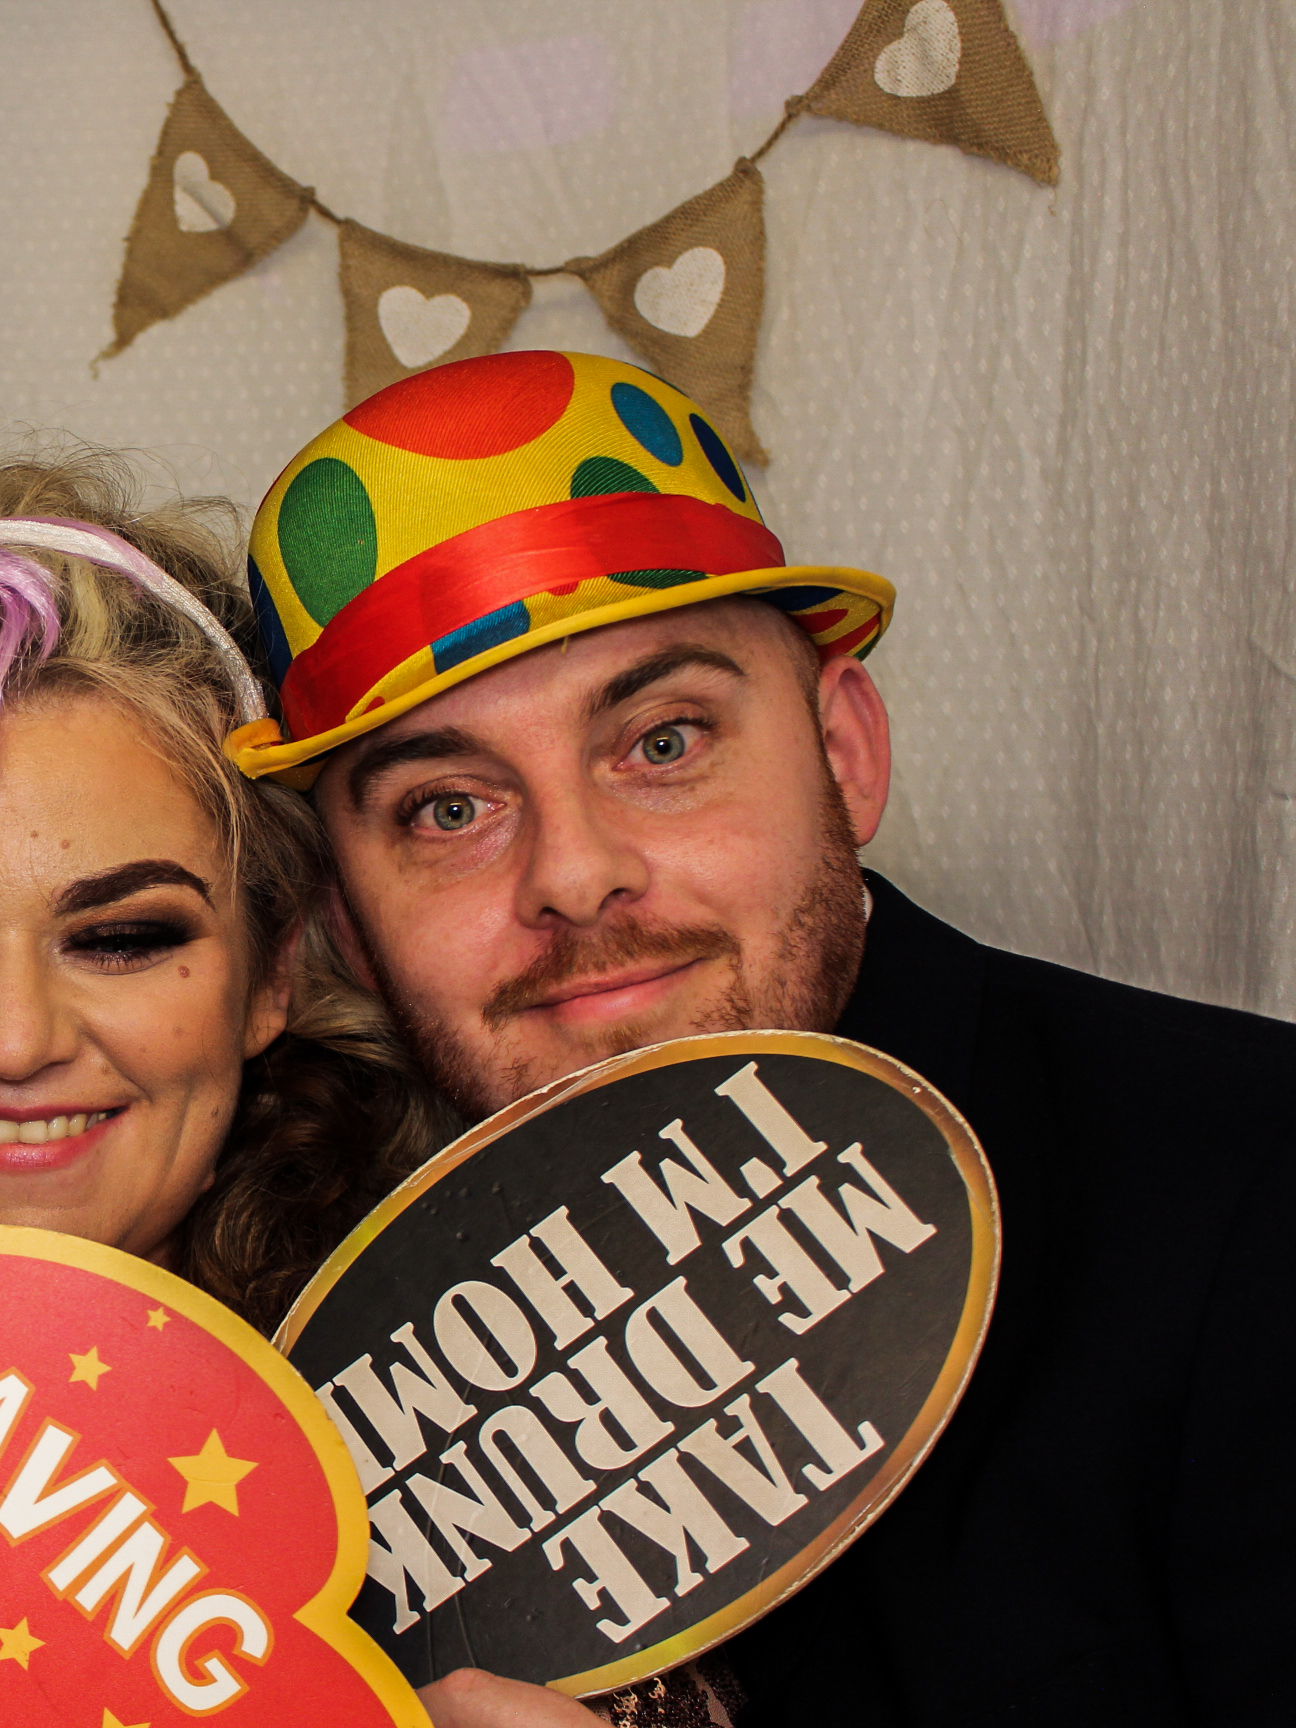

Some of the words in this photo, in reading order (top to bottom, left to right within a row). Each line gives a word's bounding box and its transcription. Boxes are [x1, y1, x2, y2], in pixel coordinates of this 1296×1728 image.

[600, 1061, 828, 1266] I'M
[722, 1142, 938, 1336] ME
[366, 1276, 756, 1635] DRUNK
[542, 1358, 886, 1644] TAKE
